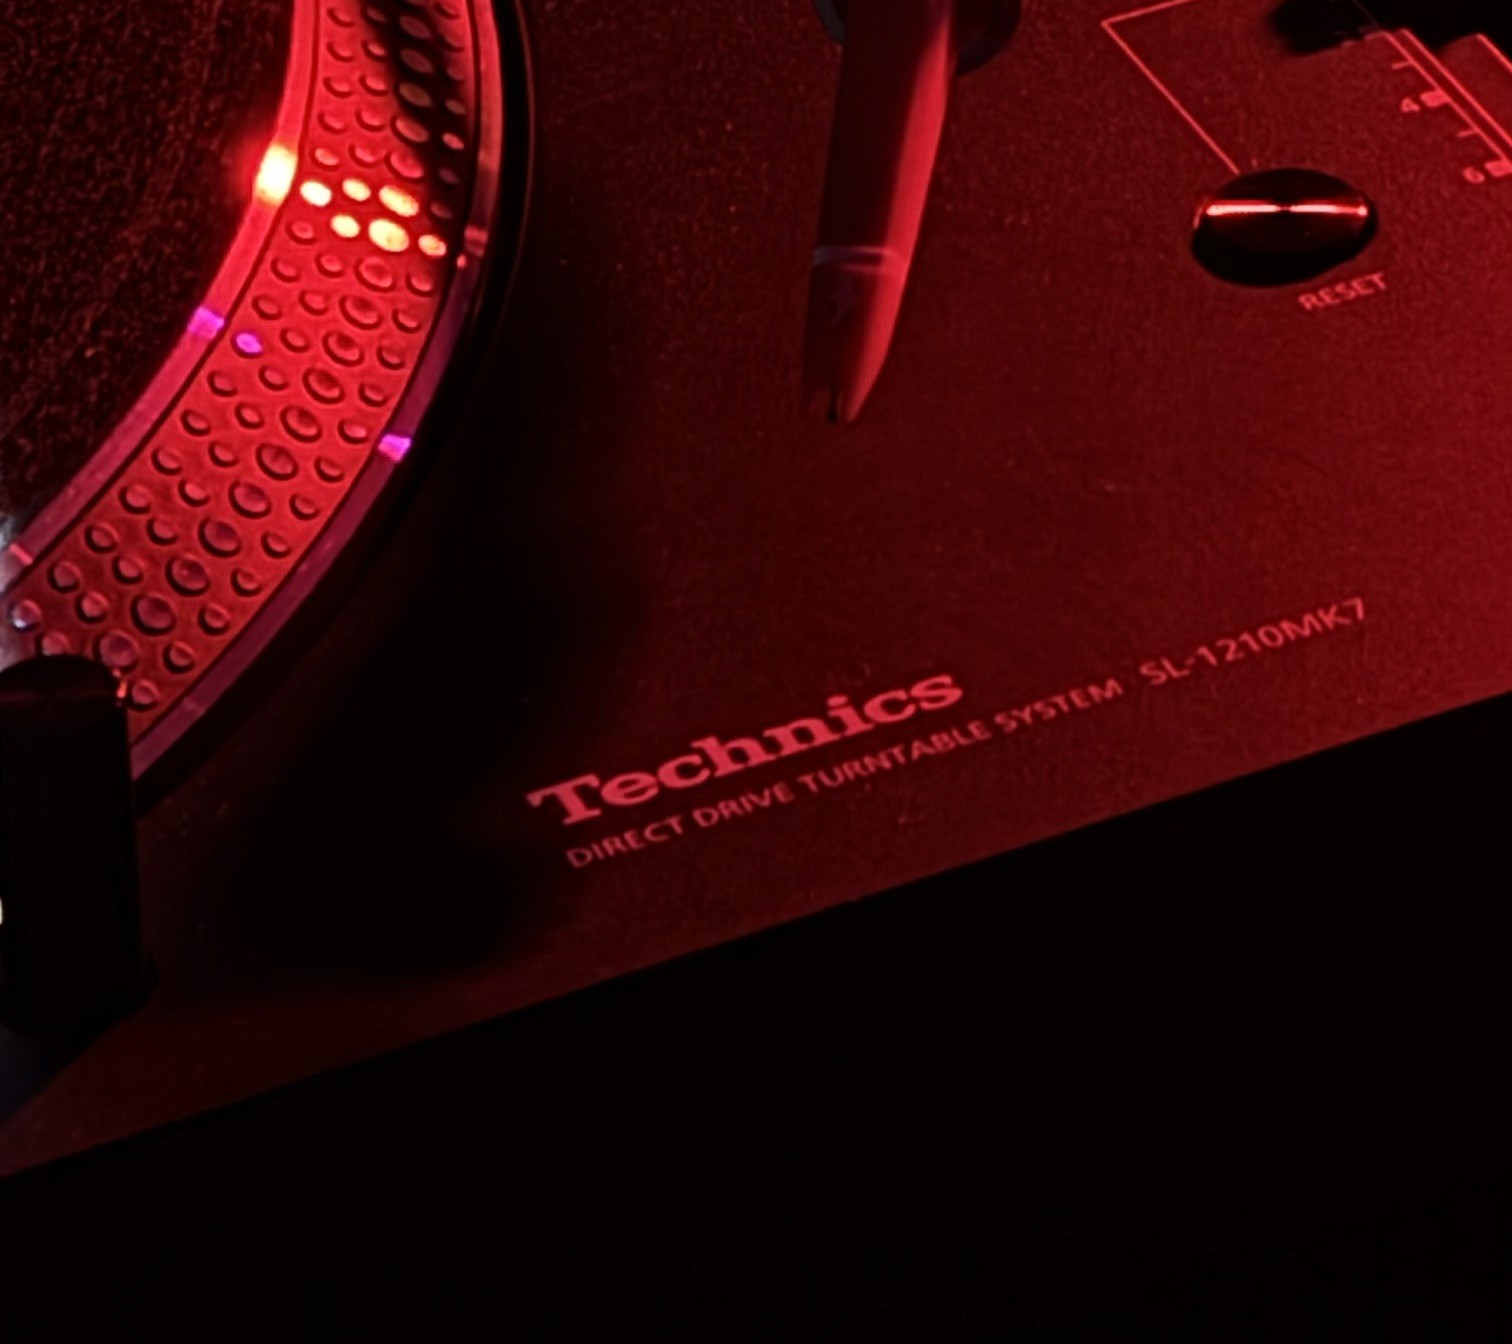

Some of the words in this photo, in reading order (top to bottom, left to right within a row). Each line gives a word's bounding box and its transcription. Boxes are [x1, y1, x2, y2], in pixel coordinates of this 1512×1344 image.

[1299, 271, 1389, 312] RESET
[526, 673, 964, 827] Technics
[566, 814, 685, 869] DIRECT
[690, 780, 795, 828] DRIVE
[796, 720, 991, 795] TURNTABLE
[994, 676, 1125, 735] SYSTEM
[1137, 594, 1368, 687] SL-1210MK7
